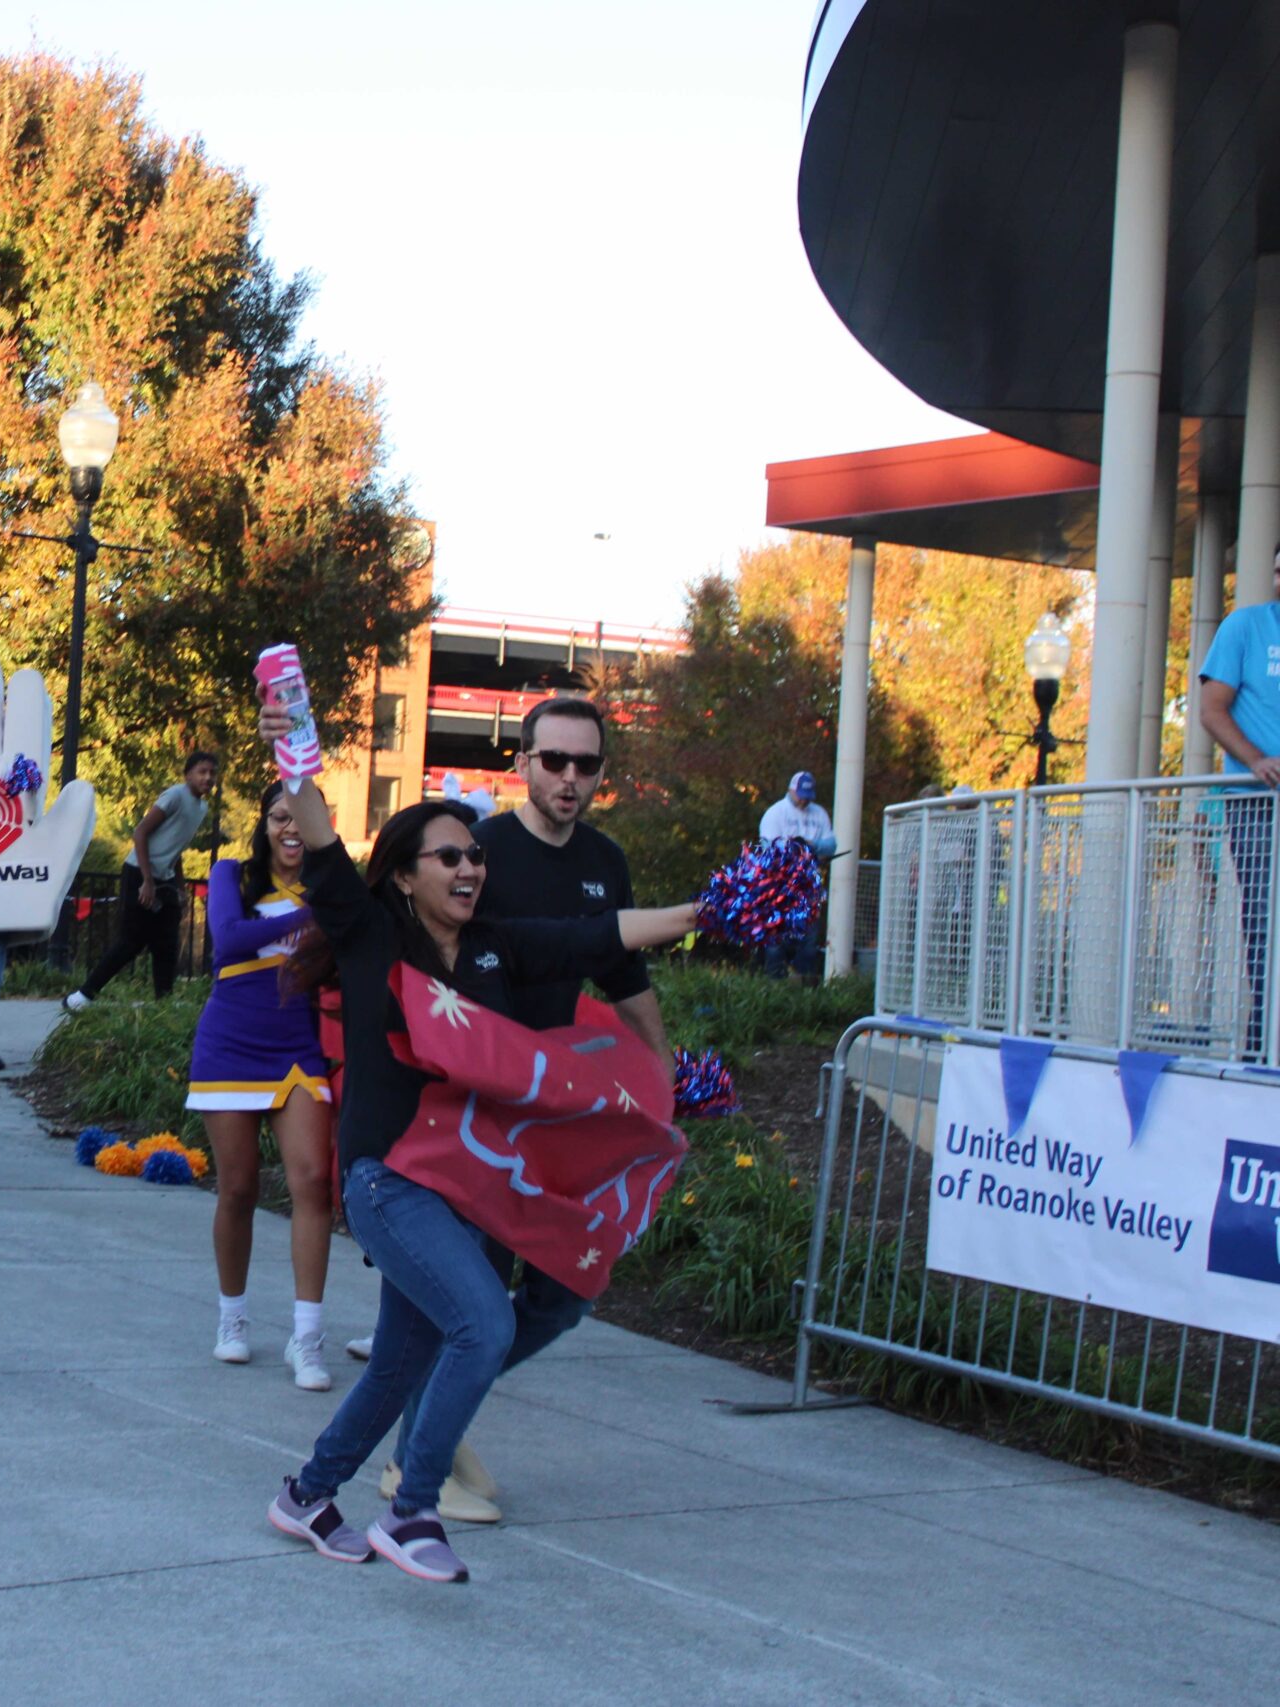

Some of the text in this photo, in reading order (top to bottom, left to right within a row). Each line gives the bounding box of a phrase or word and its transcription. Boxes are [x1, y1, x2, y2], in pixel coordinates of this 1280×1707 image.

[946, 1123, 1103, 1188] United Way
[937, 1168, 1193, 1252] of Roanoke Valley
